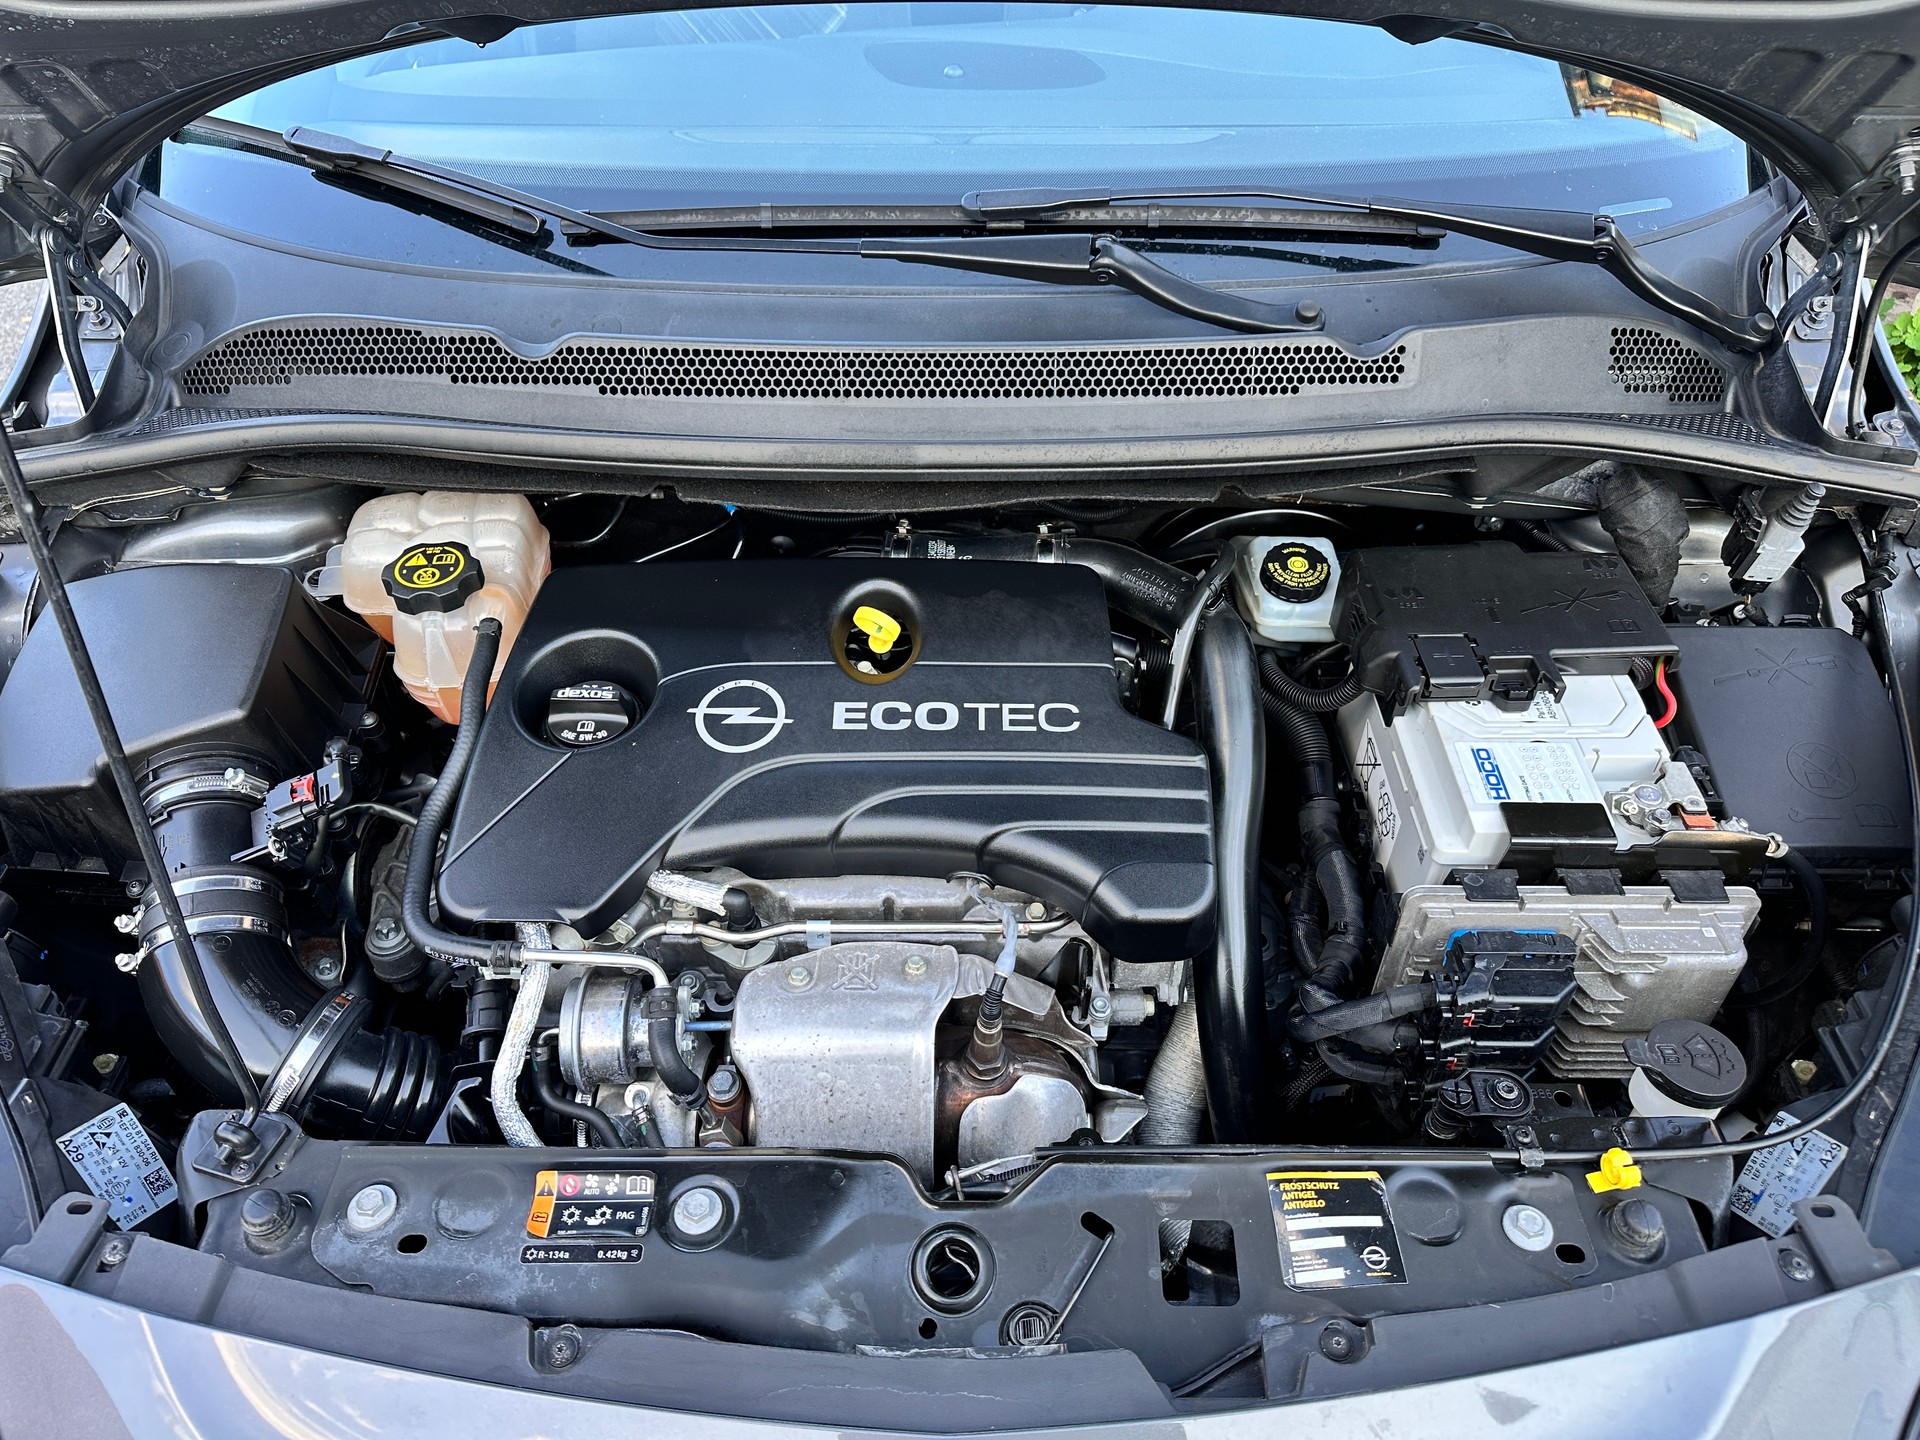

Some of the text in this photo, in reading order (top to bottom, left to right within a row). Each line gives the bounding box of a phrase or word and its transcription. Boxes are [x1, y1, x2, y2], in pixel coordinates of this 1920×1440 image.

[556, 687, 616, 699] dexos
[718, 681, 771, 692] OPEL
[832, 701, 1080, 732] ECOTEC
[561, 730, 608, 741] SAE 5W-30
[1476, 748, 1507, 800] HOCO
[117, 1119, 128, 1132] 1EF
[125, 1132, 136, 1144] 011
[127, 1118, 159, 1162] 133 81 344 RH
[59, 1138, 85, 1163] A29
[1819, 1142, 1842, 1168] A29
[100, 1156, 108, 1165] HC
[116, 1155, 128, 1169] 12V
[1743, 1163, 1754, 1176] 133
[1750, 1155, 1759, 1164] 81
[1783, 1154, 1794, 1167] 12V
[1750, 1168, 1762, 1181] 1EF
[1758, 1155, 1769, 1168] 011
[1280, 1182, 1340, 1191] FROSTSCHUTZ
[1282, 1191, 1318, 1200] ANTIGEL
[1283, 1200, 1326, 1210] ANTIGELO
[616, 1211, 635, 1220] PAG
[538, 1250, 628, 1260] R-134a 0.42kg
